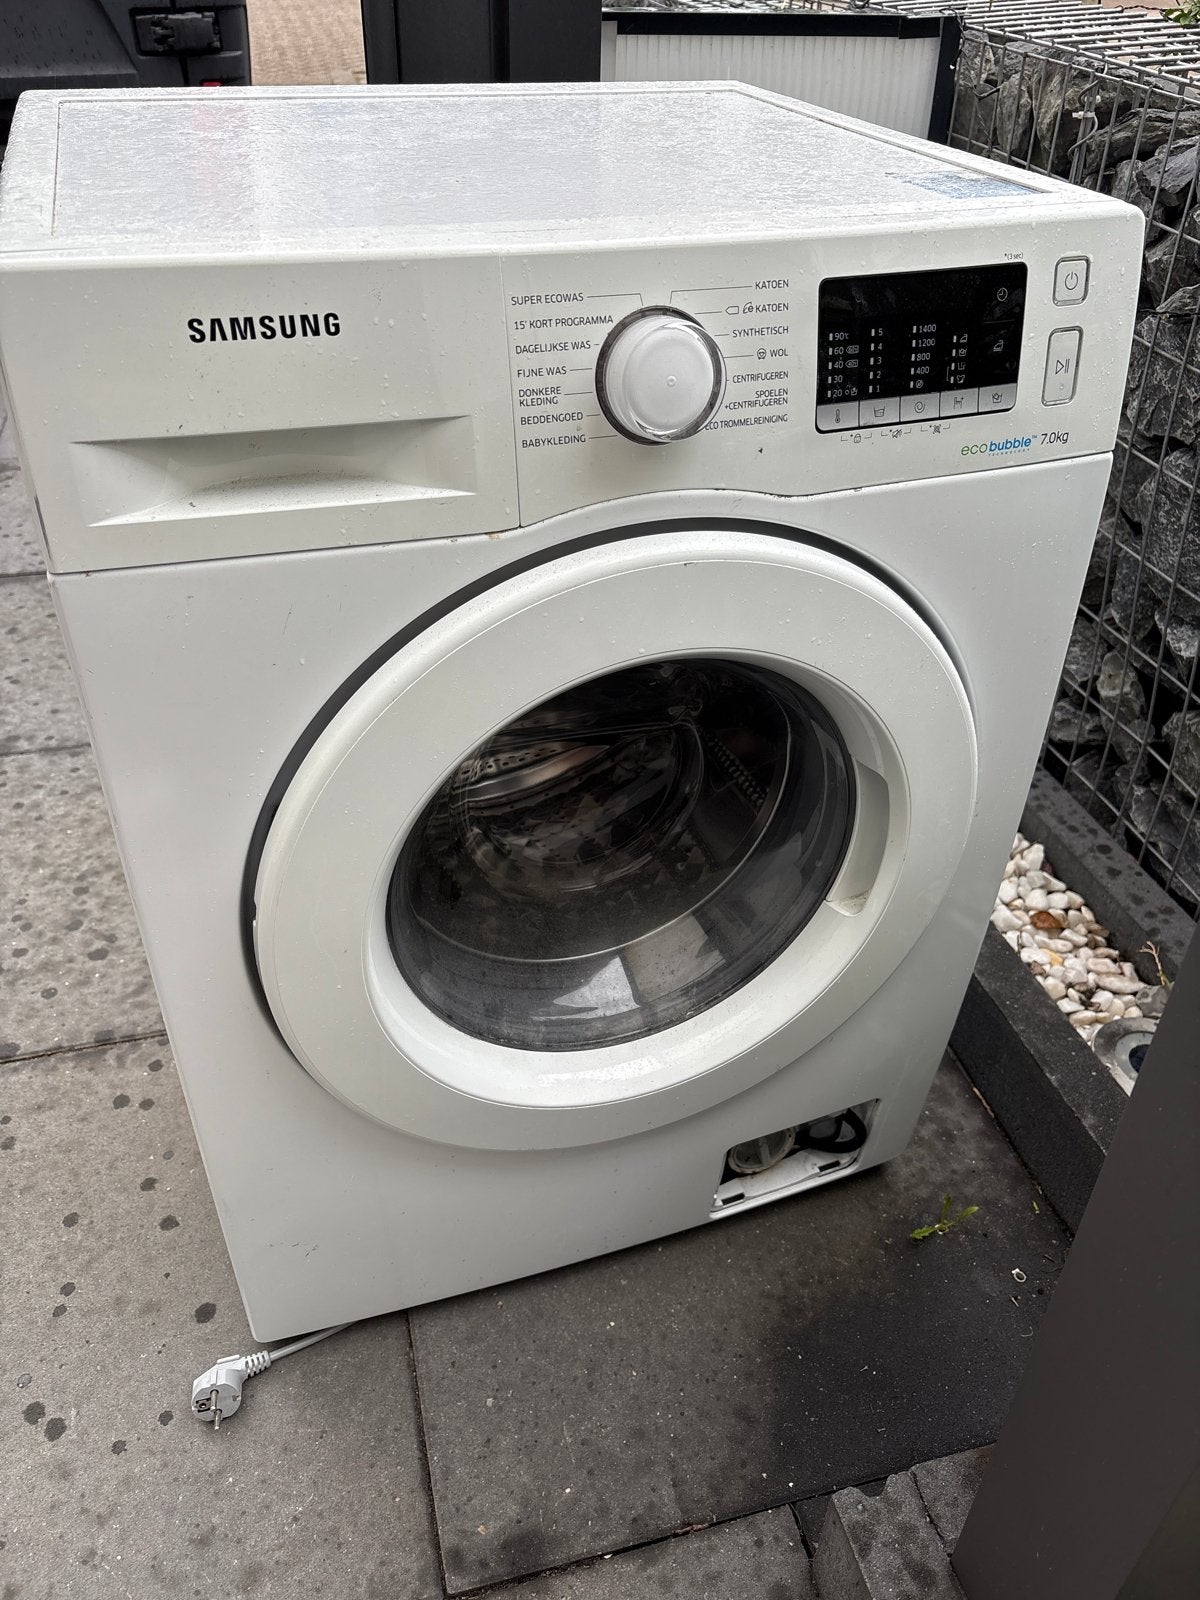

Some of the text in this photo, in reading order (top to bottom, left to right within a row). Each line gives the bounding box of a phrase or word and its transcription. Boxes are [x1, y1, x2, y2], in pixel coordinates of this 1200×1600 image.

[755, 279, 789, 290] KATOEN
[511, 292, 584, 306] SUPER ECOWAS
[755, 302, 789, 313] KATOEN
[529, 318, 553, 329] KORT
[555, 315, 614, 327] PROGRAMMA
[187, 312, 341, 344] SAMSUNG
[732, 325, 789, 338] SYNTHETISCH
[878, 327, 883, 337] 5
[919, 323, 937, 333] 1400
[515, 340, 591, 354] DAGELIJKSE WAS
[877, 342, 883, 350] 4
[918, 338, 936, 347] 1200
[769, 348, 789, 357] WOL
[833, 346, 845, 355] 60
[877, 356, 882, 365] 3
[916, 352, 931, 361] 800
[833, 360, 844, 369] 40
[915, 365, 930, 375] 400
[517, 366, 567, 378] FIJNE WAS
[732, 370, 789, 384] CENTRIFUGEREN
[876, 370, 882, 379] 2
[833, 374, 844, 384] 30
[518, 386, 562, 398] DONKERE
[755, 388, 789, 399] SPOELEN
[833, 388, 843, 398] 20
[519, 396, 559, 407] KLEDING
[725, 397, 788, 411] +CENTRIFUGEREN
[520, 412, 583, 426] BEDDENGOED
[720, 413, 788, 429] TROMMELREINIGING
[522, 434, 586, 449] BABYKLEDING
[1040, 430, 1069, 446] 7.0kg
